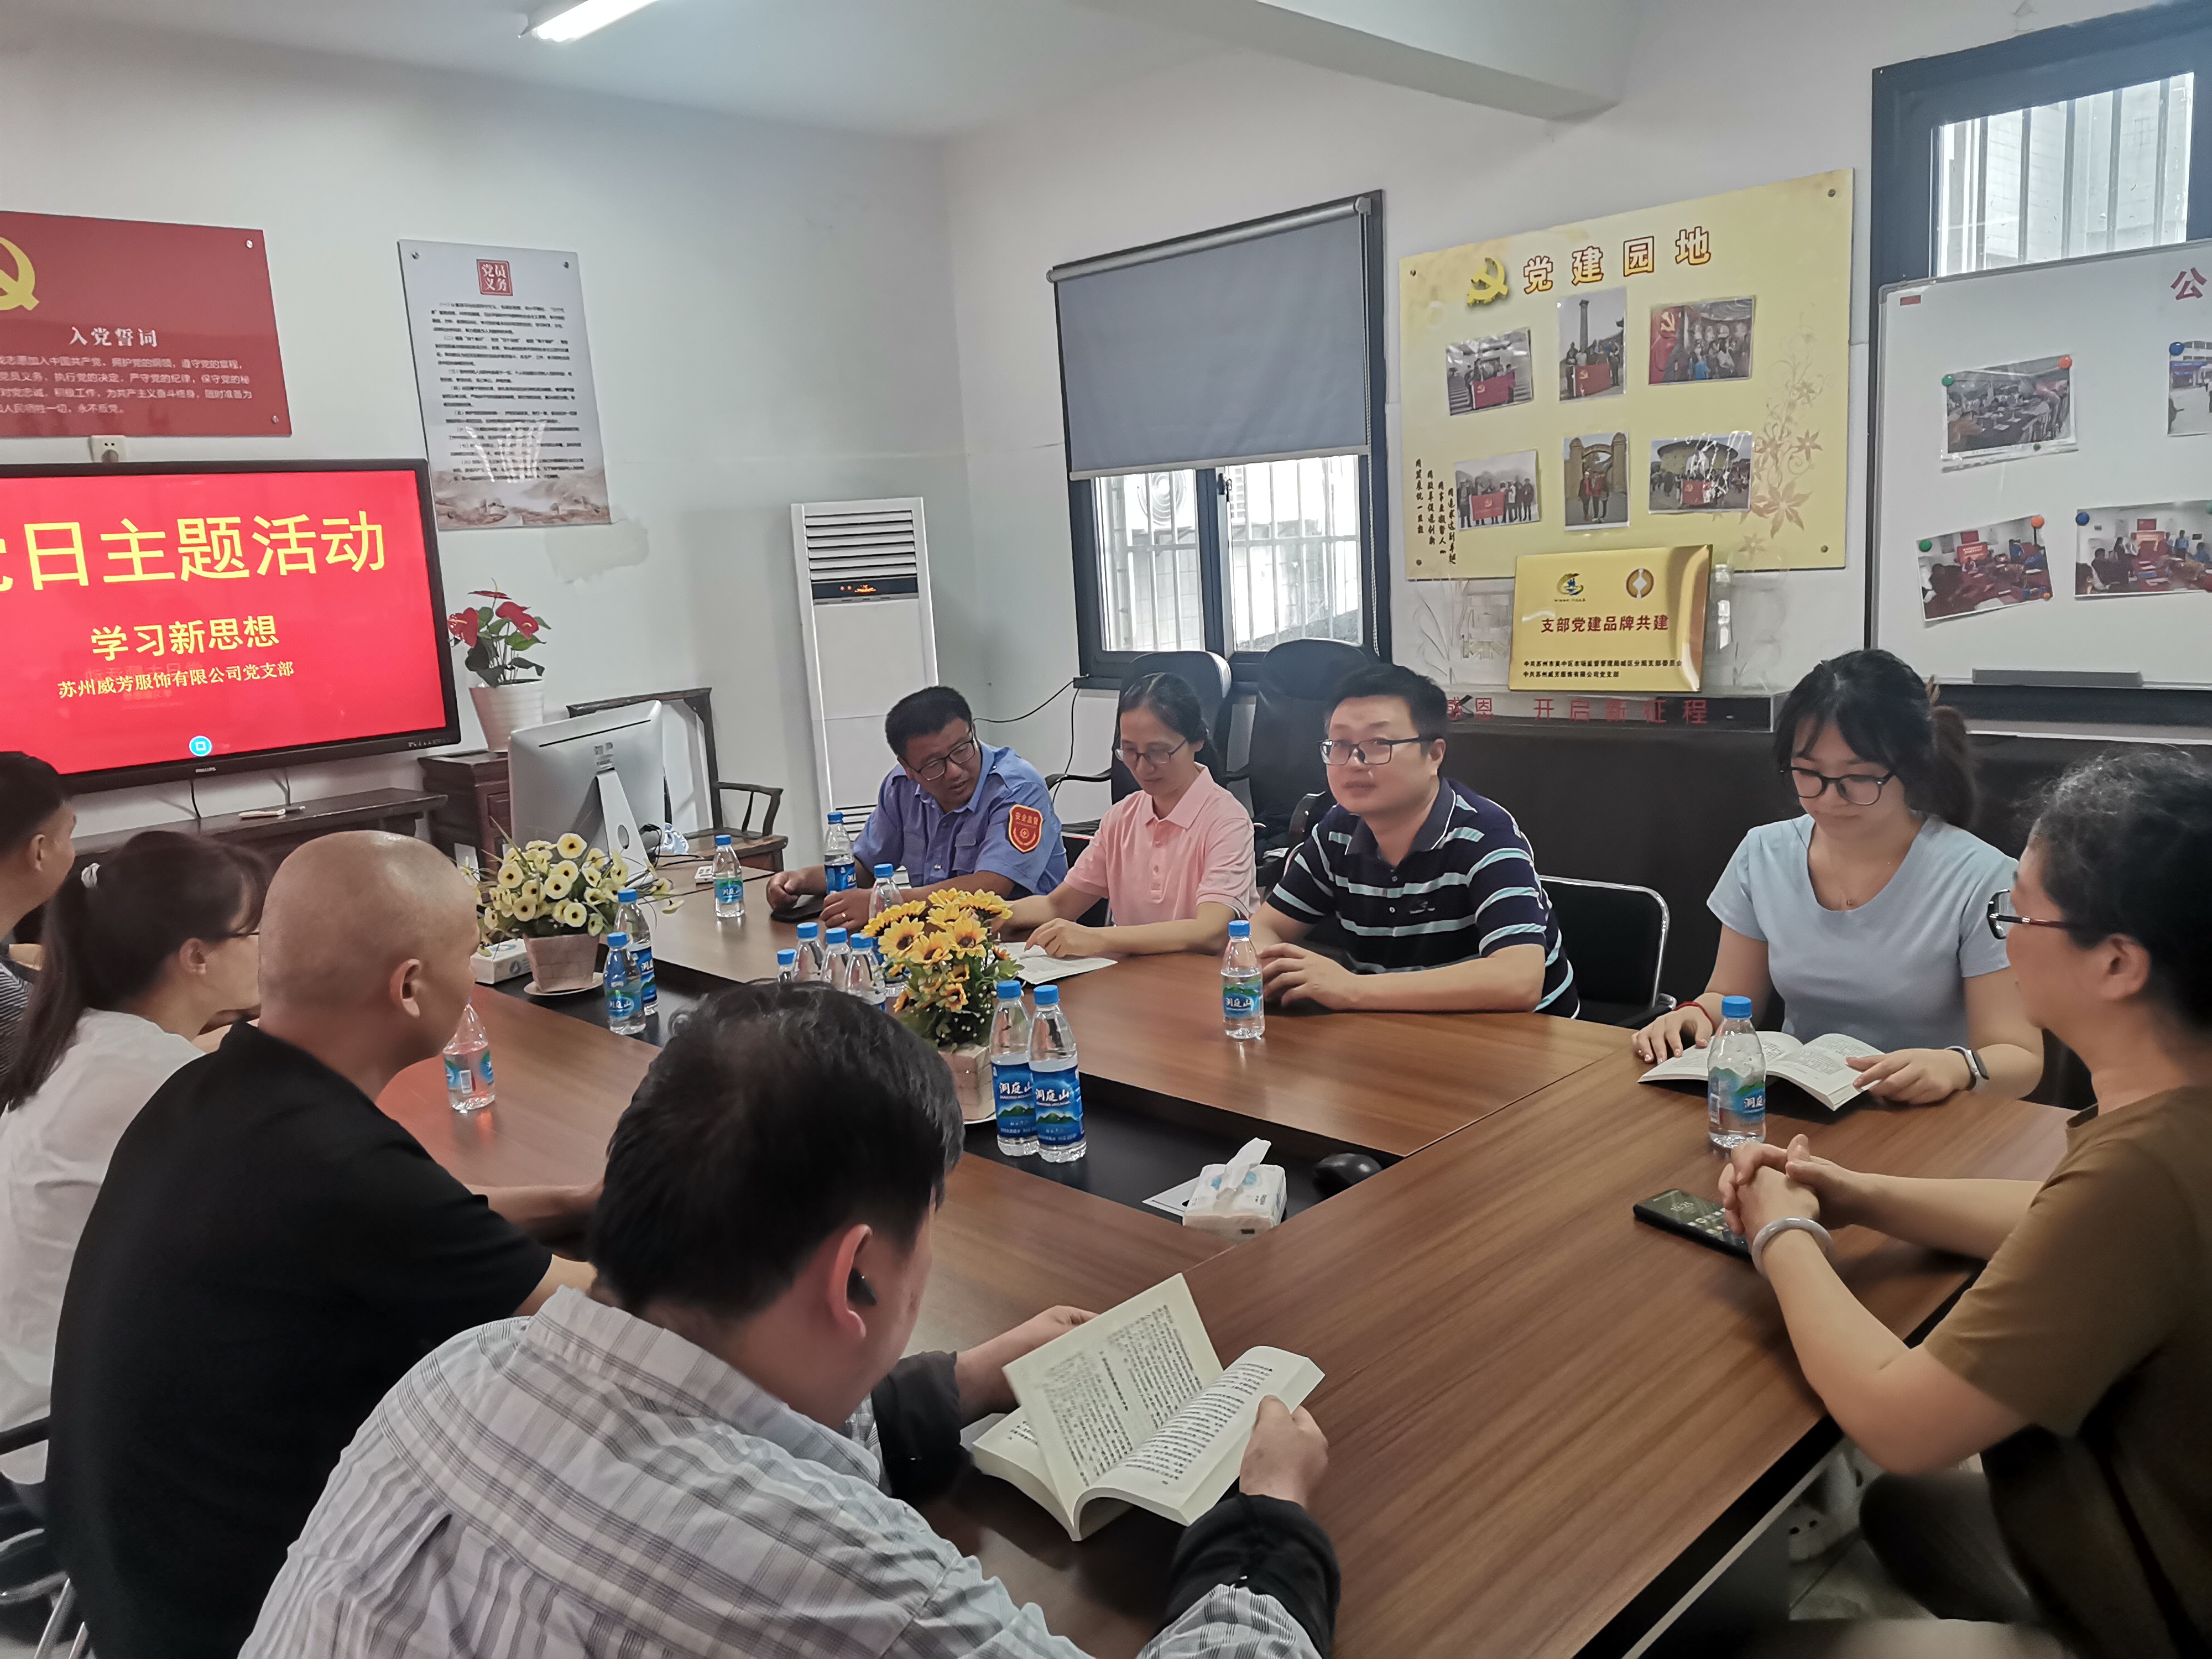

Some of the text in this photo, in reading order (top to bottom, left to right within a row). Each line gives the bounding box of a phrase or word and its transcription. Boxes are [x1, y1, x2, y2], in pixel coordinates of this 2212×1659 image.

[1524, 226, 1711, 289] 党建园地
[2170, 267, 2208, 300] 公
[69, 325, 158, 347] 入党誓词
[0, 510, 385, 592] 日主题活动
[91, 615, 280, 661] 学习新思想
[1541, 614, 1669, 633] 支部党建品牌共建
[58, 661, 295, 698] 苏州威芳服饰有限公司党支部
[1035, 1089, 1069, 1102] 洞庭山
